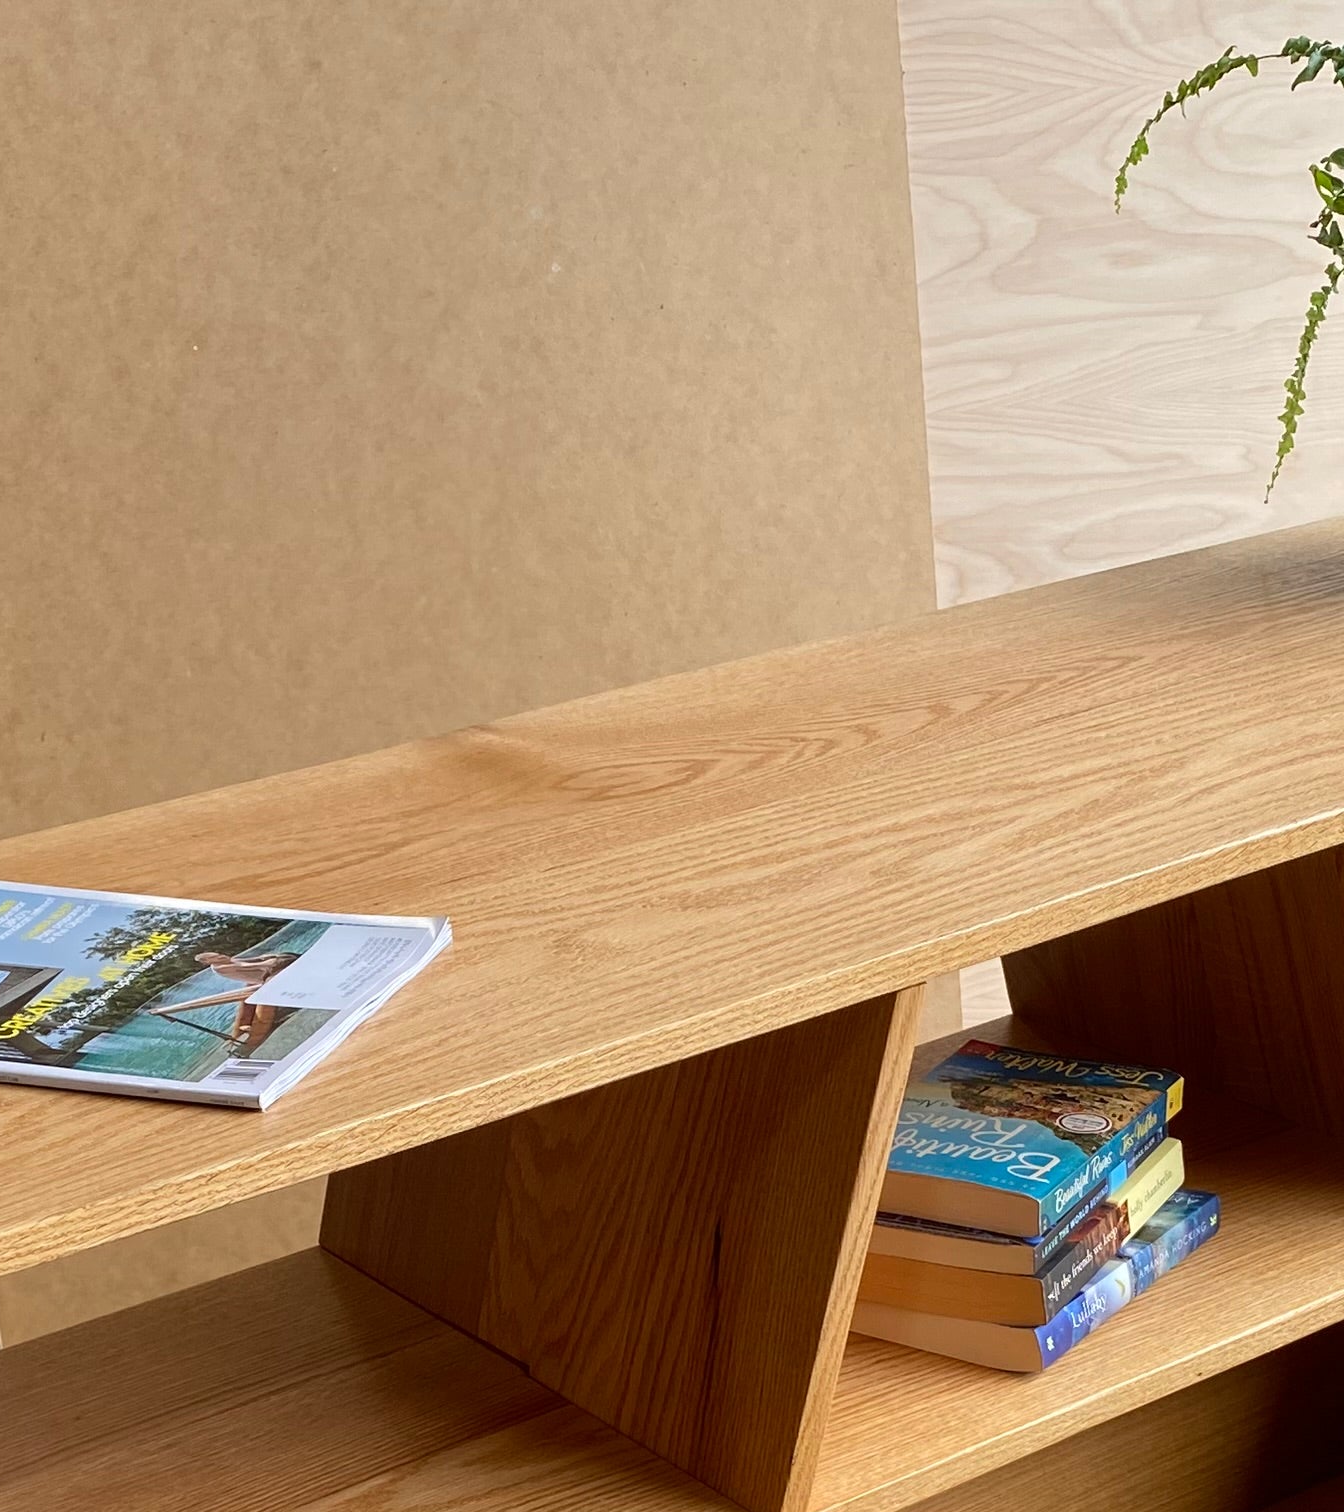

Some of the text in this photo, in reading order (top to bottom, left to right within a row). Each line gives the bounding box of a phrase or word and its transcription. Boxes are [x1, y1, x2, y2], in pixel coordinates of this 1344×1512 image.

[118, 931, 177, 964] HOME
[985, 1050, 1165, 1088] Jess Walter
[890, 1127, 1061, 1184] Beautif
[897, 1111, 1028, 1148] Ruins
[1054, 1164, 1090, 1214] Beautiful
[1090, 1151, 1113, 1180] Ruins
[1041, 1235, 1059, 1258] LEAVE
[1058, 1226, 1070, 1241] THE
[1070, 1204, 1090, 1229] WORLD
[1060, 1272, 1072, 1290] the
[1071, 1248, 1094, 1279] friends
[1092, 1243, 1103, 1256] we
[1102, 1226, 1118, 1247] keep
[1138, 1220, 1208, 1280] AMANDA HOCKING
[1070, 1291, 1108, 1329] Lullaby
